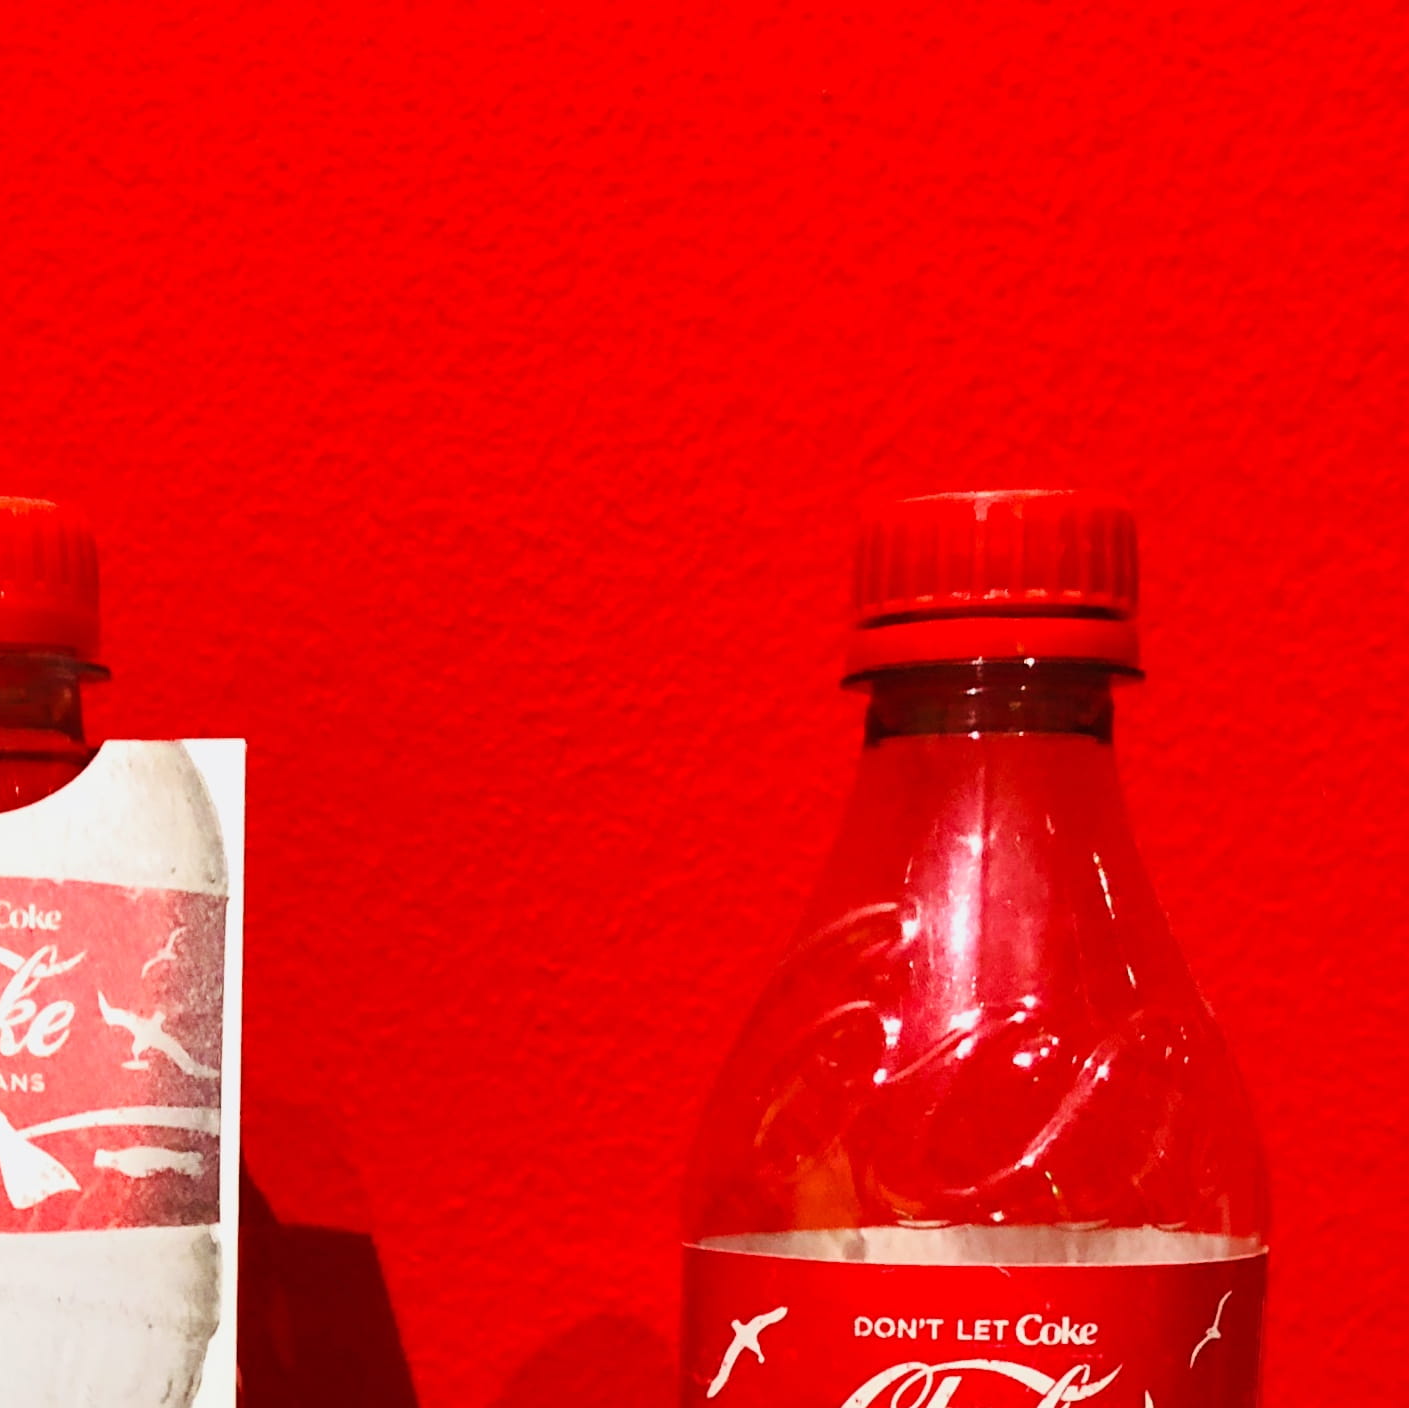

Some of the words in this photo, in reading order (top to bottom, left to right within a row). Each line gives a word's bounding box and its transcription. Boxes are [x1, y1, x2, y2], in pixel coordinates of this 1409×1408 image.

[854, 1316, 945, 1340] DON'T
[956, 1319, 1010, 1341] LET
[1015, 1313, 1099, 1346] Coke
